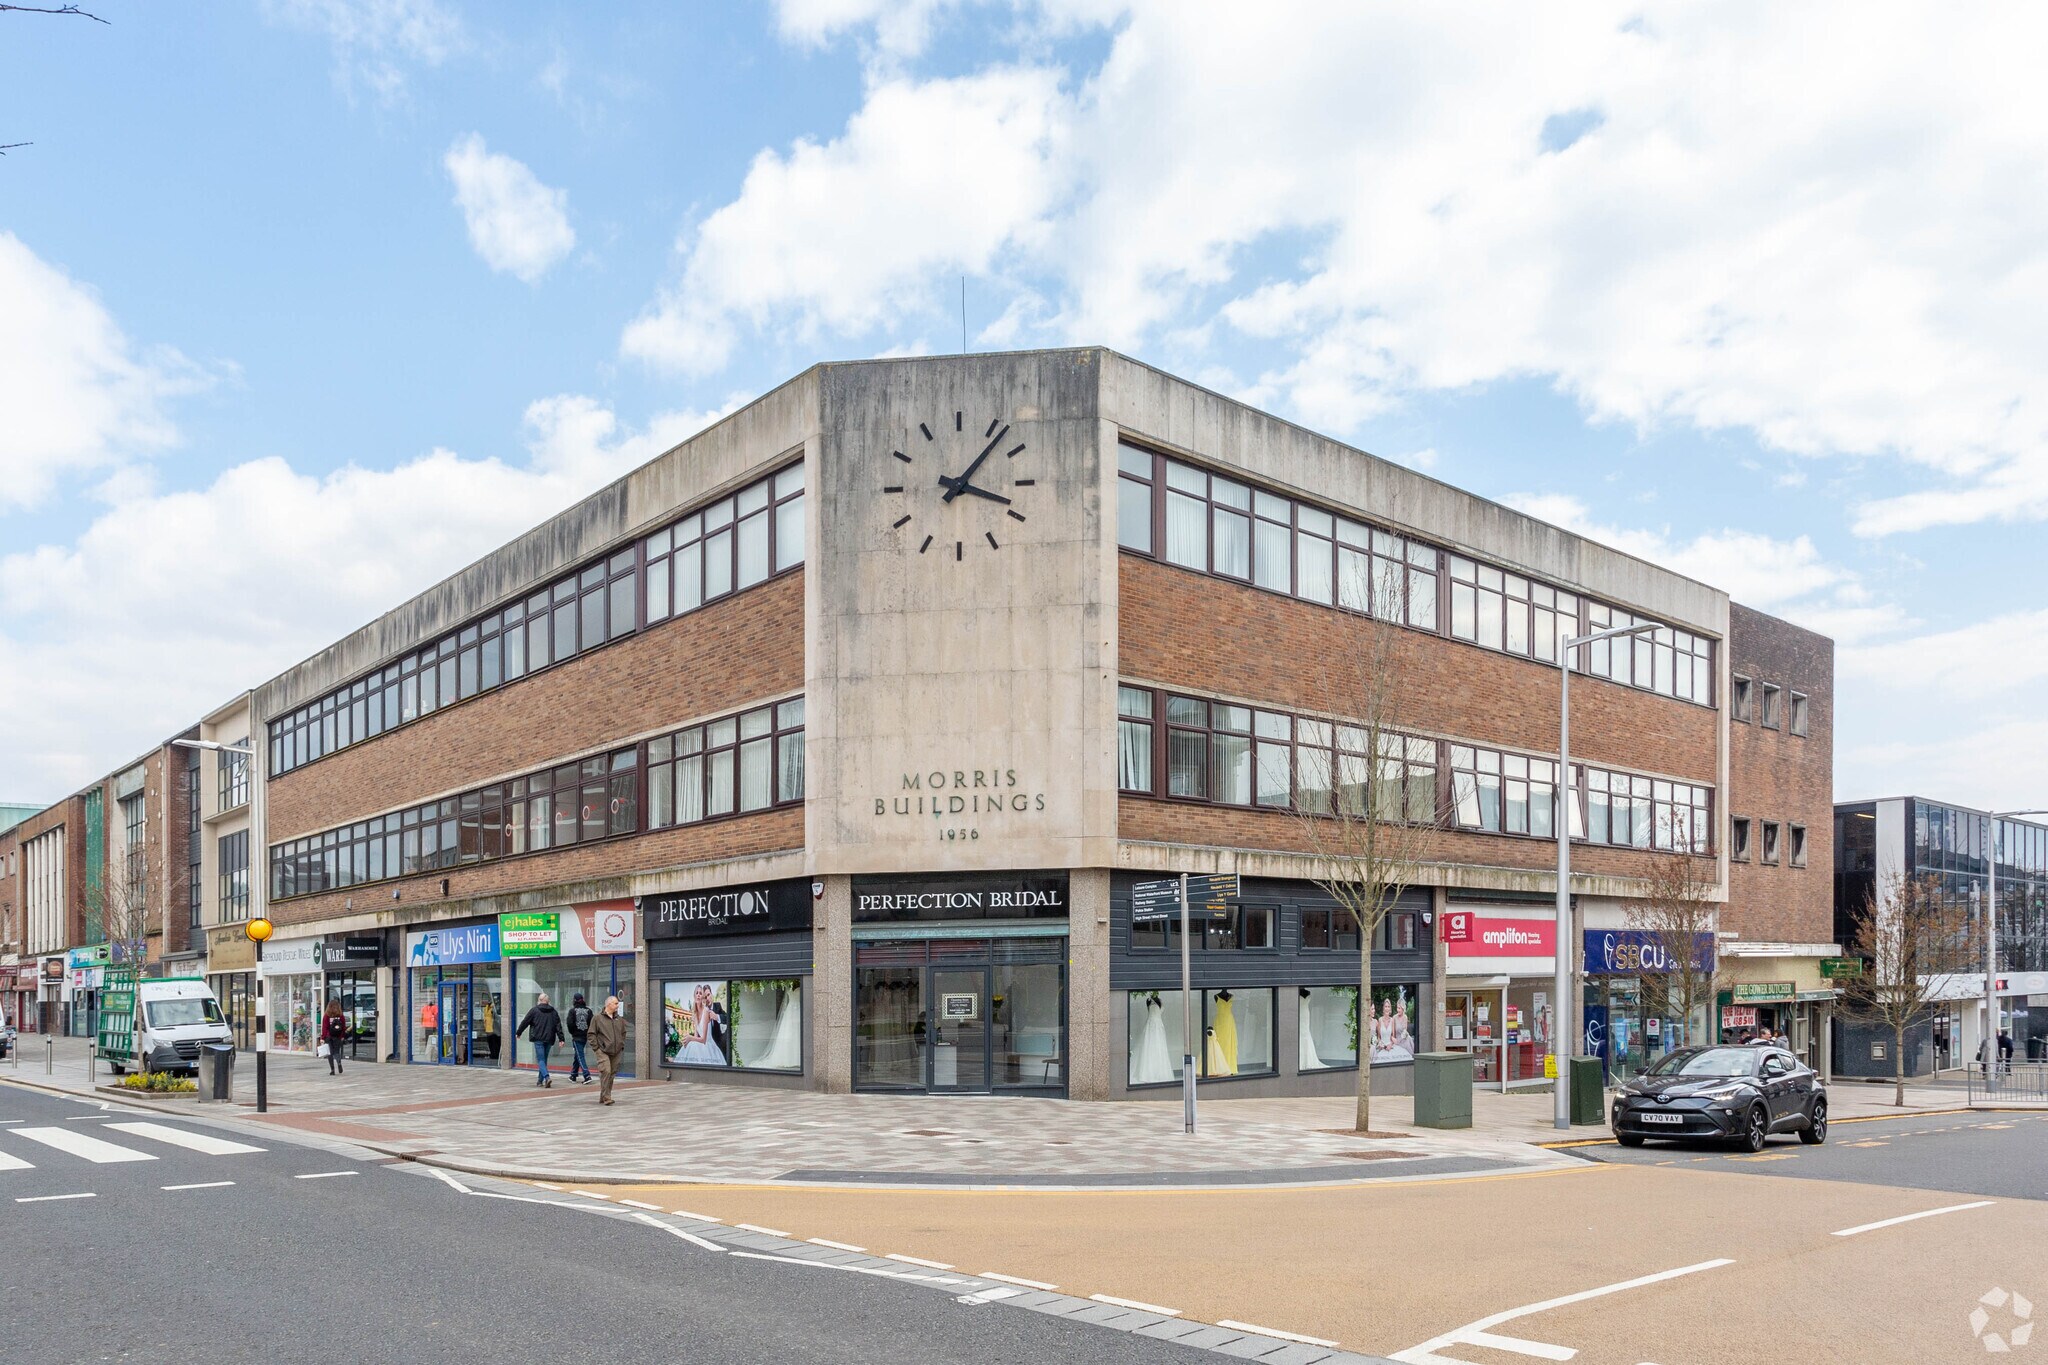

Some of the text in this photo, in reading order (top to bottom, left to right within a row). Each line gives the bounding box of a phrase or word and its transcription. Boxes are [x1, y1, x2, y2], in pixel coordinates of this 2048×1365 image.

[902, 769, 1016, 790] MORRIS
[875, 793, 1045, 816] BUILDINGS
[939, 828, 979, 841] 1956
[659, 889, 770, 923] PERFECTION
[858, 890, 1062, 910] PERFECTION BRIDAL
[504, 915, 544, 930] ejhales
[708, 917, 728, 926] BRIDAL
[442, 928, 491, 962] Llys Nini
[1483, 928, 1528, 949] amplifon
[325, 948, 345, 962] WARH
[1615, 944, 1665, 970] SBCU
[1737, 984, 1748, 995] THE
[1768, 983, 1792, 994] BUTCHER
[1644, 1114, 1679, 1122] CV70 VAY
